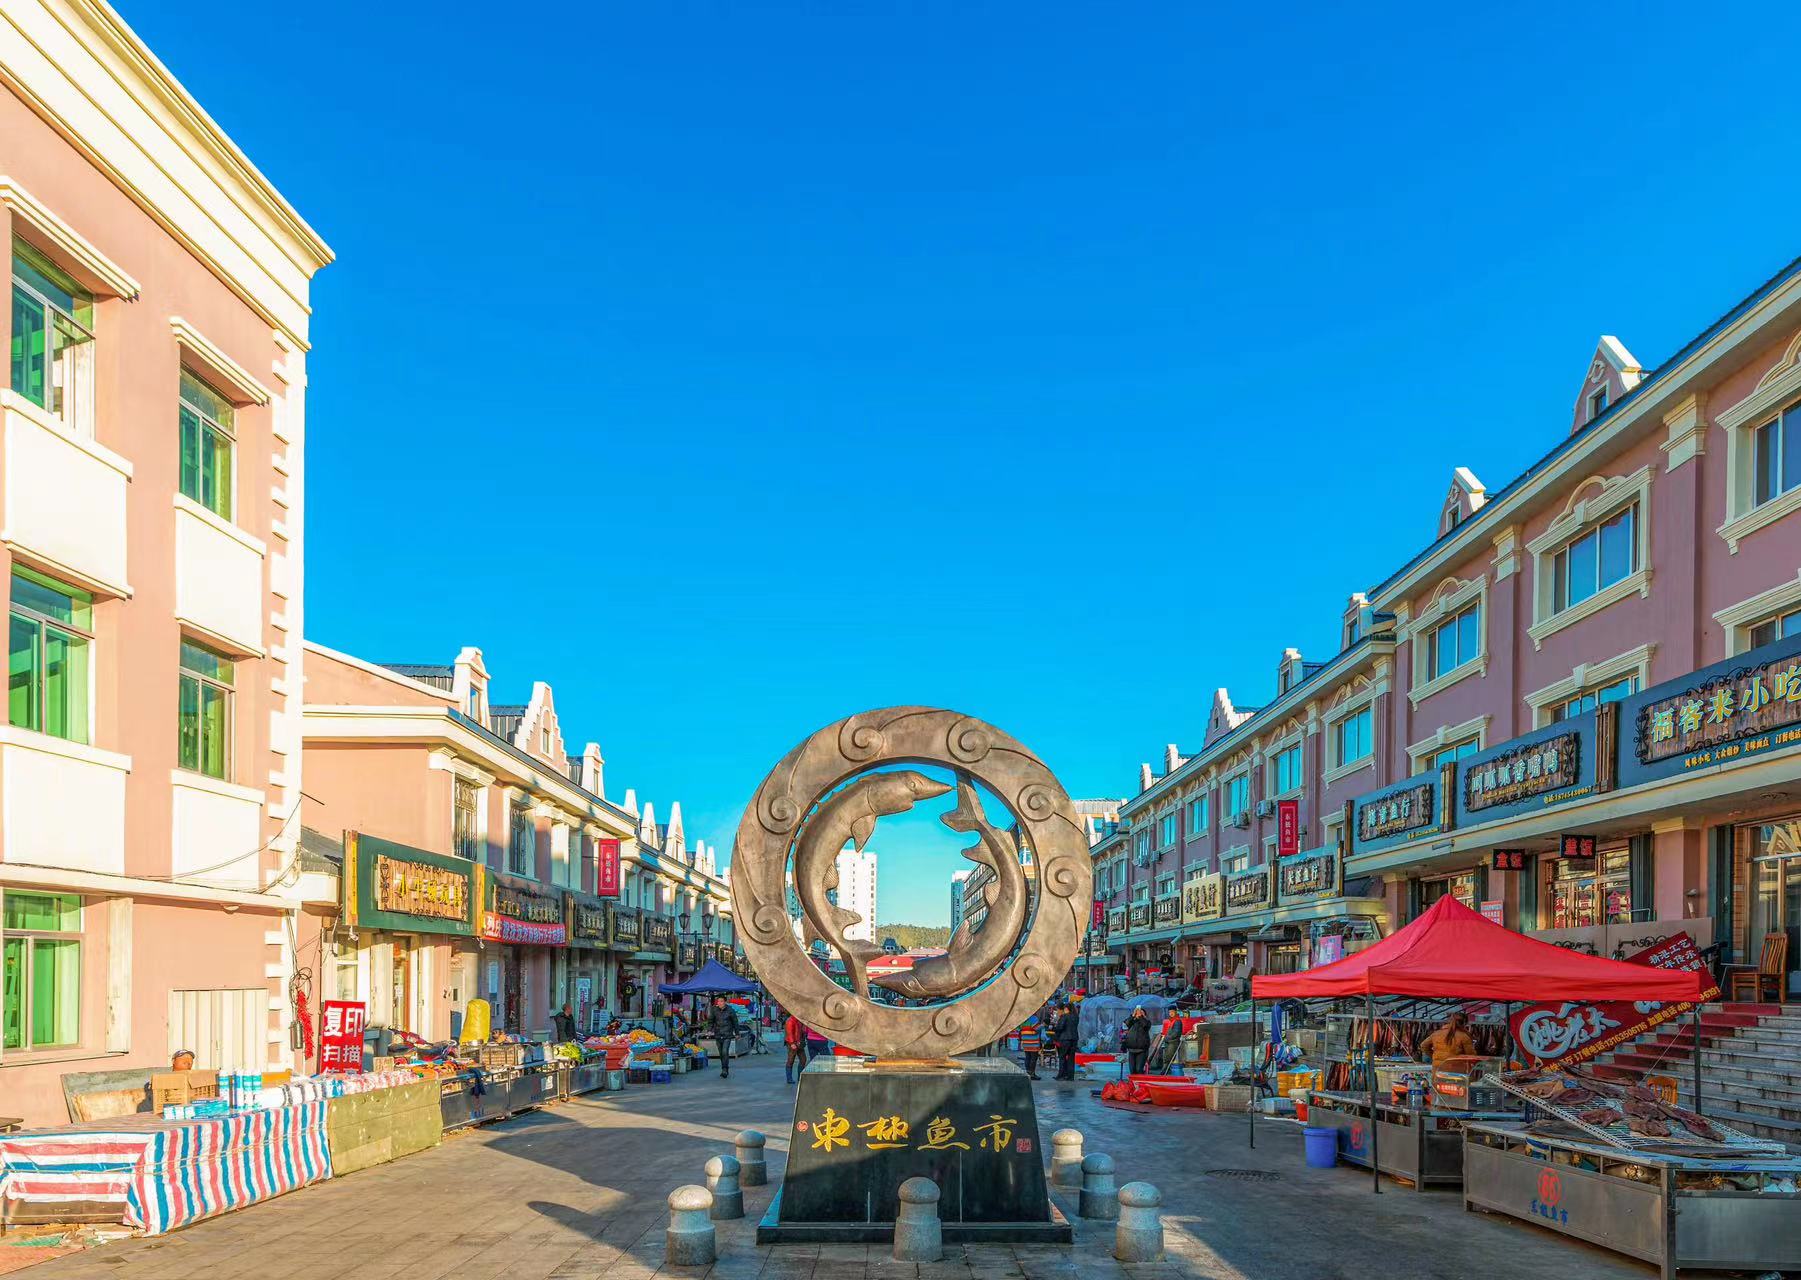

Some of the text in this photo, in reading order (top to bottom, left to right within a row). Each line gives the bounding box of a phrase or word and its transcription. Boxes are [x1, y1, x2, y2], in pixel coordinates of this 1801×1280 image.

[1651, 665, 1801, 743] 福客来小吃
[323, 1006, 365, 1037] 复印
[323, 1043, 361, 1063] 扫描
